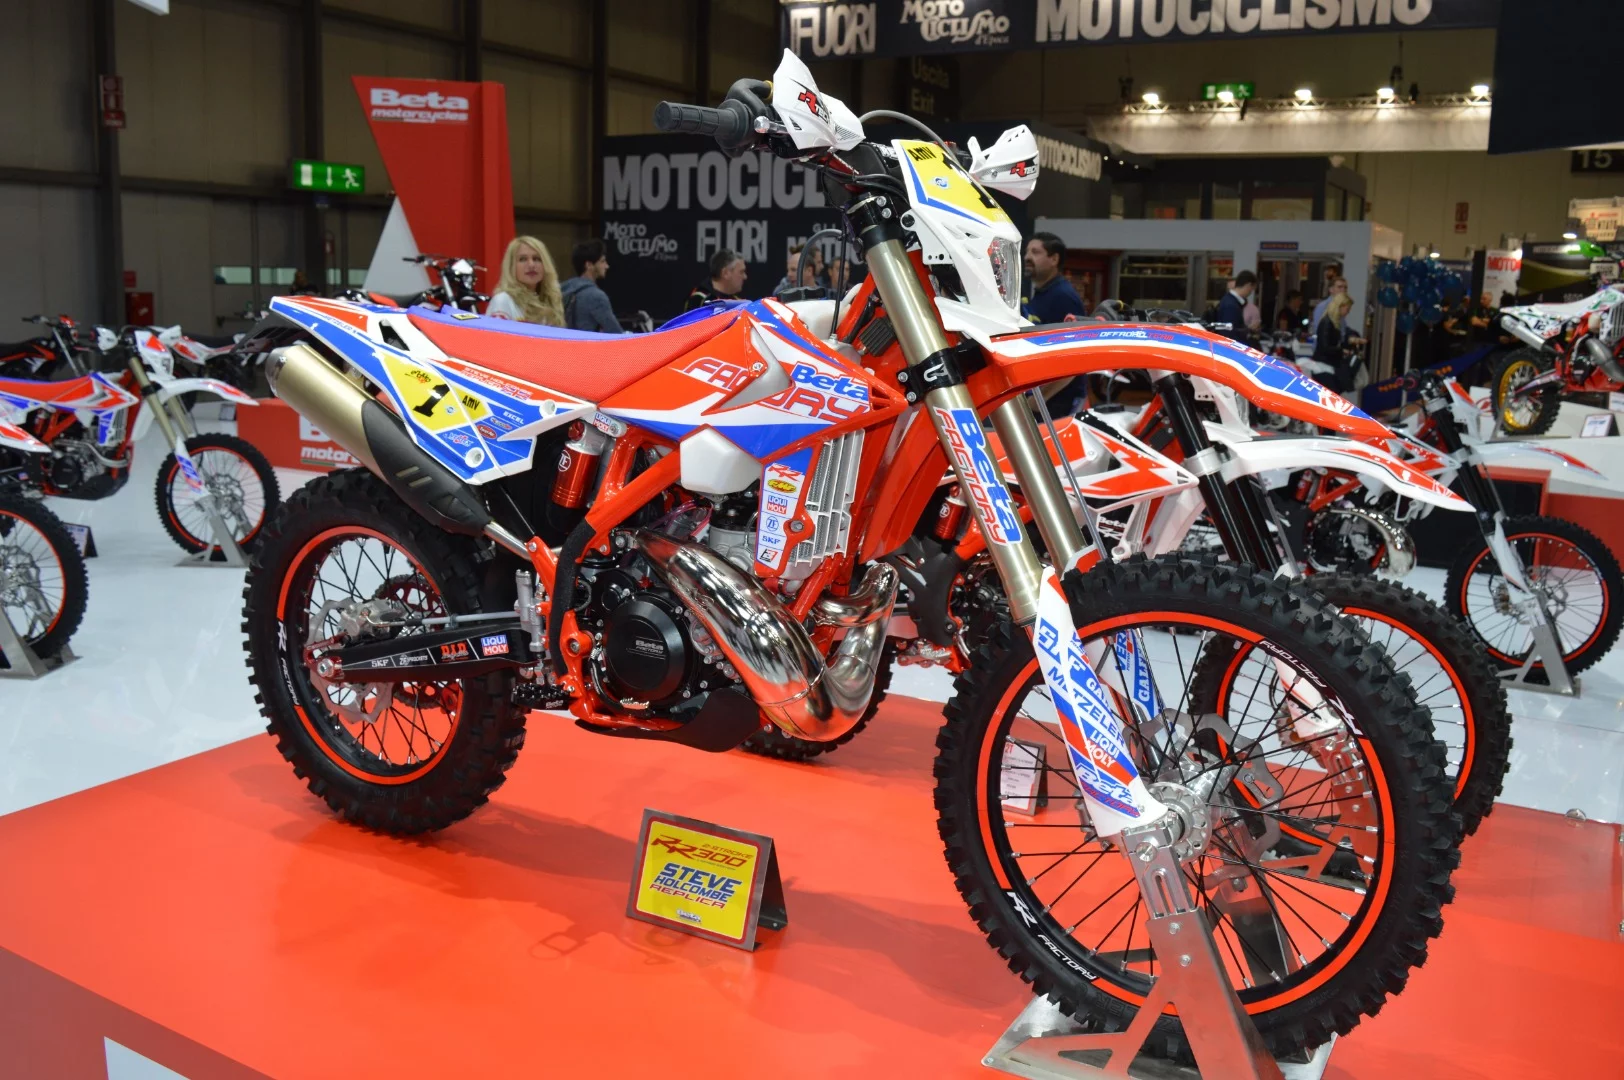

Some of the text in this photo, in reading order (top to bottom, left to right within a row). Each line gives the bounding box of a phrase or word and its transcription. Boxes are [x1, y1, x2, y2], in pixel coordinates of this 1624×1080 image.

[901, 0, 965, 24] MOTO
[790, 3, 876, 57] FUORI
[920, 9, 1010, 43] CICLISMO
[370, 88, 469, 110] Beta
[371, 108, 469, 123] motorcycles
[603, 221, 647, 240] MOTO
[617, 233, 679, 257] CICLISMO
[683, 356, 869, 423] FACRY
[791, 362, 870, 400] Beta
[413, 383, 451, 418] 1
[934, 407, 1007, 546] FACTORY
[951, 408, 1023, 544] Beta
[767, 504, 787, 515] MOLY
[768, 495, 788, 506] LIQUI
[762, 535, 781, 545] SKF
[481, 635, 507, 647] LIQUI
[482, 644, 509, 656] MOLY
[635, 639, 664, 651] Beta
[371, 659, 389, 668] SKF
[1260, 640, 1327, 688] FACTORY
[1048, 666, 1126, 747] MTZELER
[1090, 730, 1120, 759] LIQUI
[1076, 765, 1135, 805] Beta
[691, 848, 748, 867] 300
[654, 875, 732, 902] HOLCOMBE
[660, 863, 742, 895] STEVE
[649, 883, 725, 909] REPLICA
[1038, 934, 1097, 980] FACTORY
